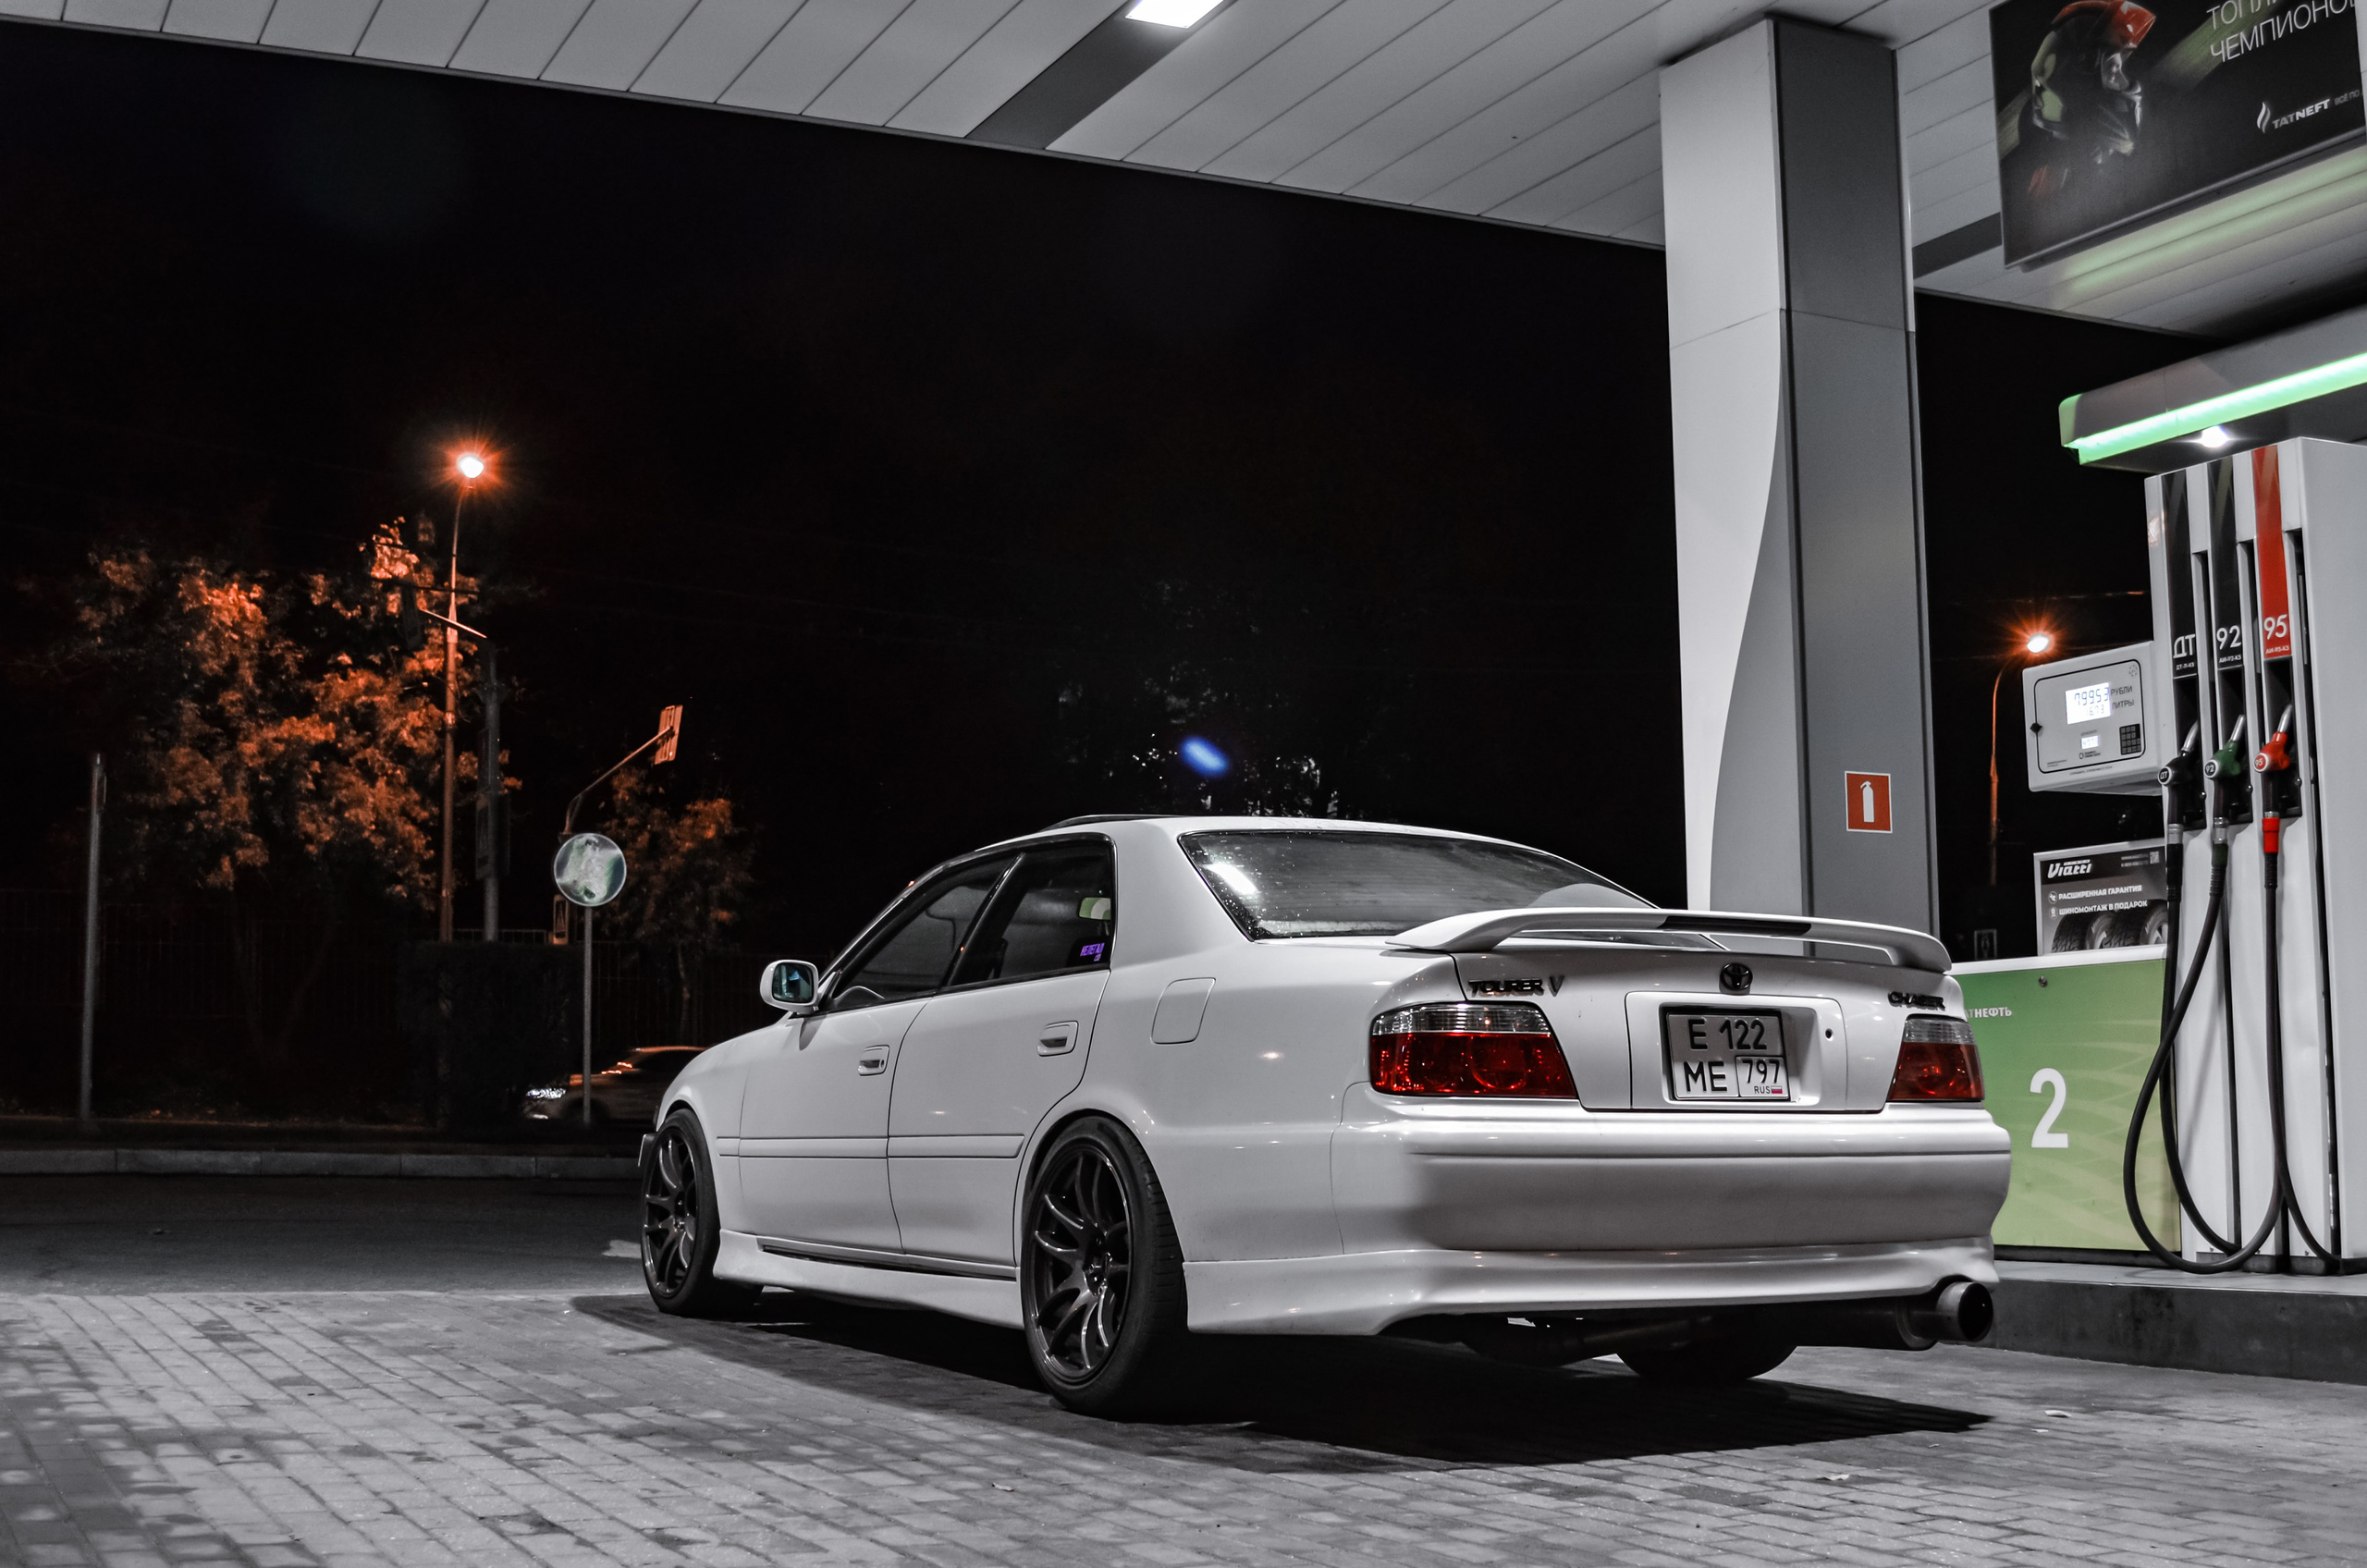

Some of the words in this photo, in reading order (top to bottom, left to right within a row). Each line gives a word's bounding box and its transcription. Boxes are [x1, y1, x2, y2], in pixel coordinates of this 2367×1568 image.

[2206, 0, 2277, 30] ТОП
[2210, 0, 2356, 62] ЧЕМПИОНО
[2272, 98, 2330, 129] TATNEFT
[2216, 625, 2242, 650] 92
[2263, 614, 2287, 640] 95
[2173, 633, 2196, 658] ДТ
[2111, 686, 2133, 695] РУБЛИ
[2112, 700, 2135, 709] ЛИТРЫ
[2205, 765, 2214, 773] 92
[2255, 758, 2263, 767] 95
[2047, 862, 2092, 878] Viatti
[2058, 888, 2107, 900] РАСШИРЕННАЯ
[2108, 885, 2142, 895] ГАРАНТИЯ
[2059, 903, 2108, 915] ШИНОМОНТАЖ
[2115, 900, 2148, 910] ПОДАРОК
[1719, 1019, 1767, 1049] 122
[1742, 1059, 1780, 1084] 797
[1754, 1085, 1771, 1094] RUS
[2030, 1068, 2069, 1148] 2
